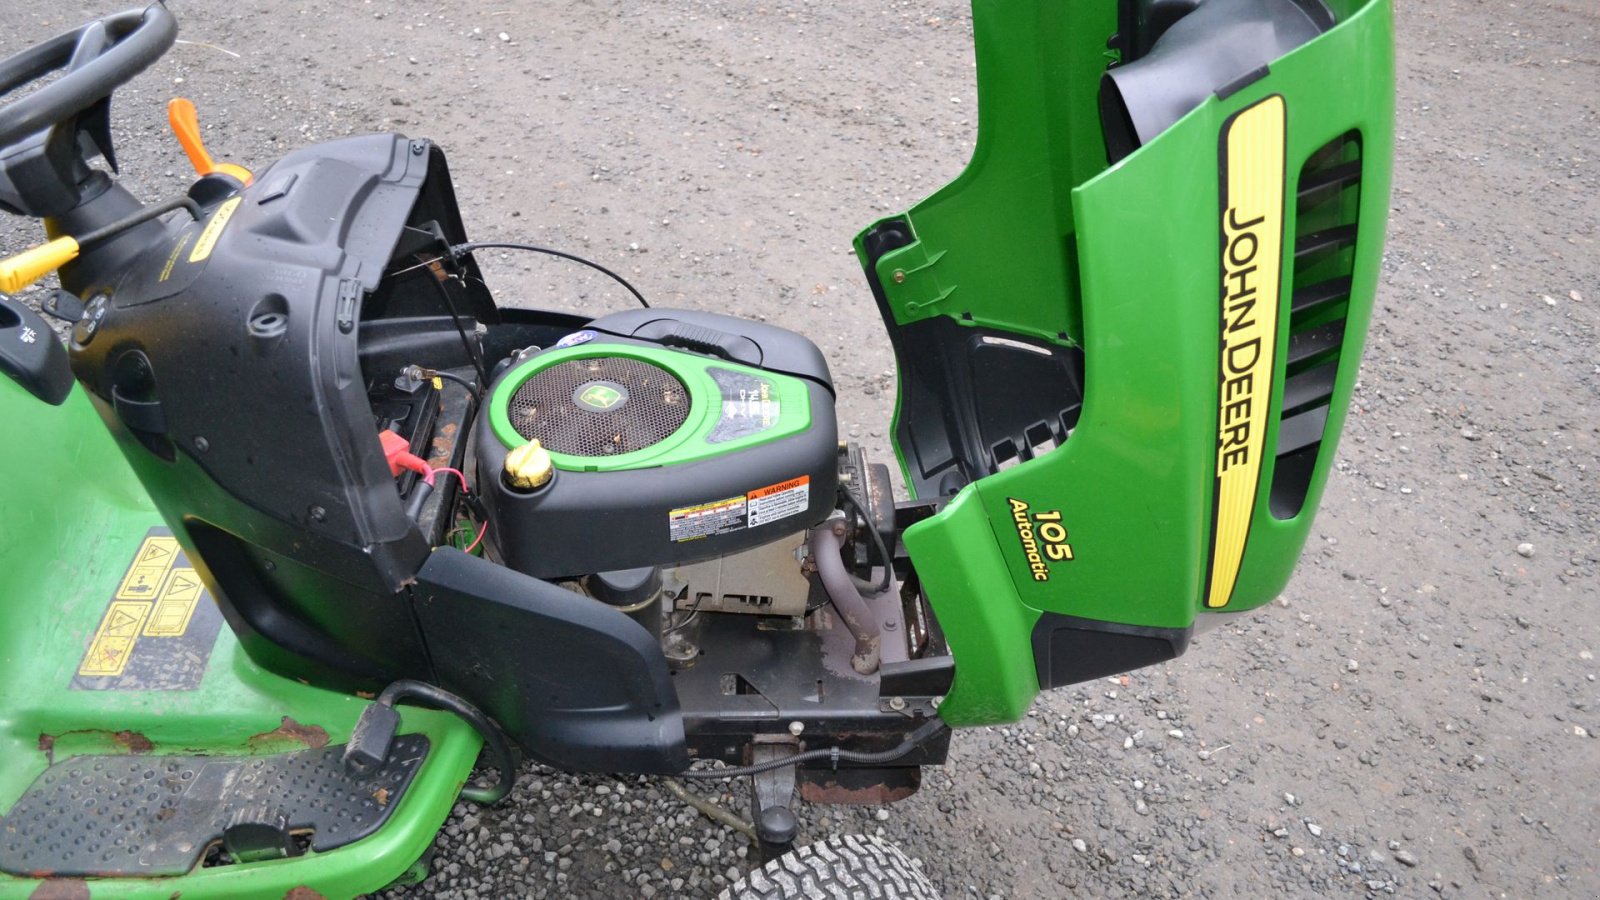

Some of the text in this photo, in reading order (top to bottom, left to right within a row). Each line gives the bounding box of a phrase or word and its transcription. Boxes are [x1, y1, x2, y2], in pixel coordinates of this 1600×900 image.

[1222, 207, 1265, 472] JOHN DEERE
[763, 480, 800, 496] WARNING
[1009, 498, 1049, 580] Automatic
[1036, 511, 1073, 560] 105
